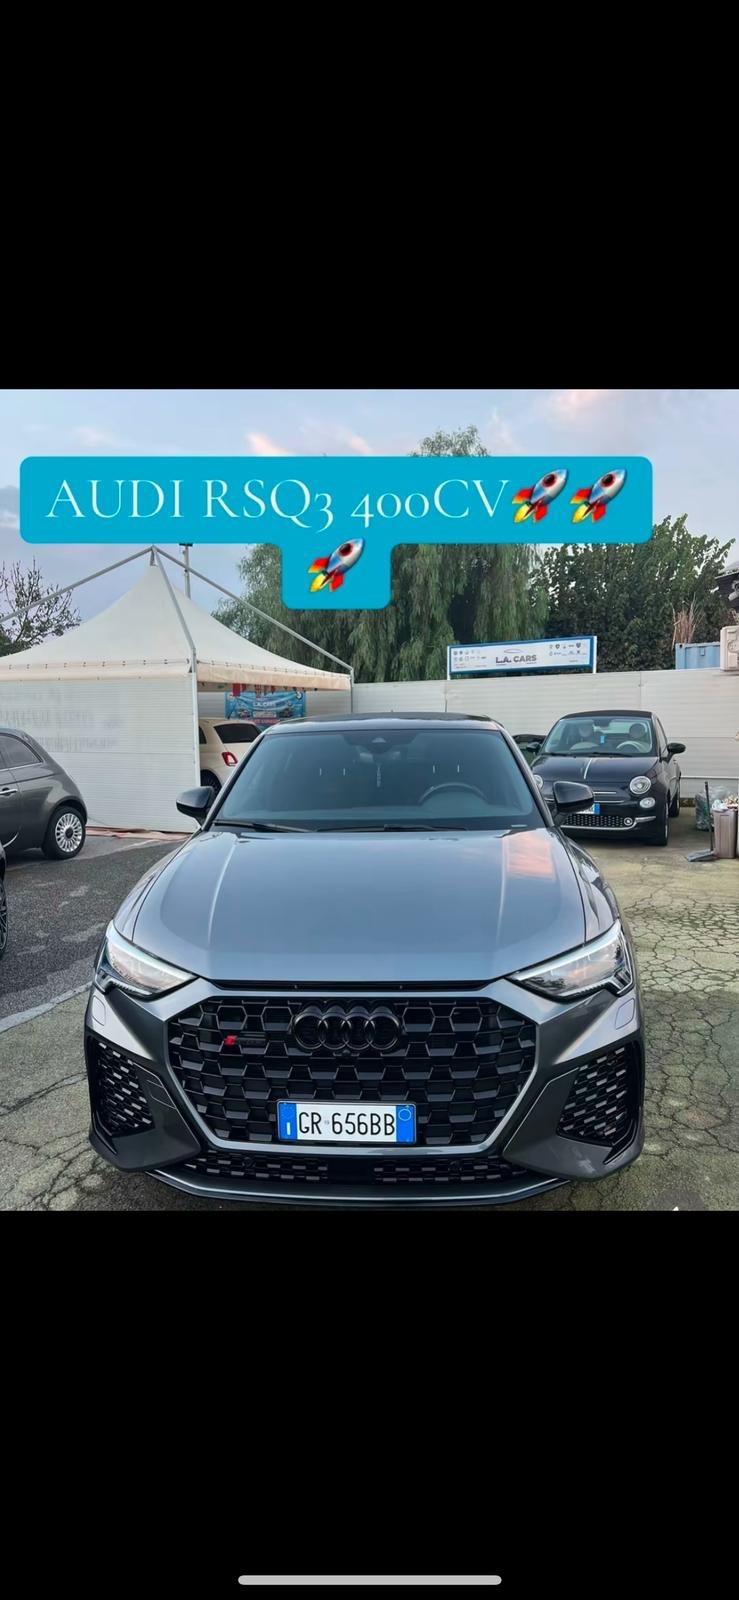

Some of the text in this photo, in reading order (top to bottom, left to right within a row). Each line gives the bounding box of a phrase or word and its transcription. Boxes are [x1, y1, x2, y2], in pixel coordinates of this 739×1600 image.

[495, 656, 512, 664] L.A.
[513, 655, 537, 663] CARS
[298, 1111, 395, 1136] GR 656BB
